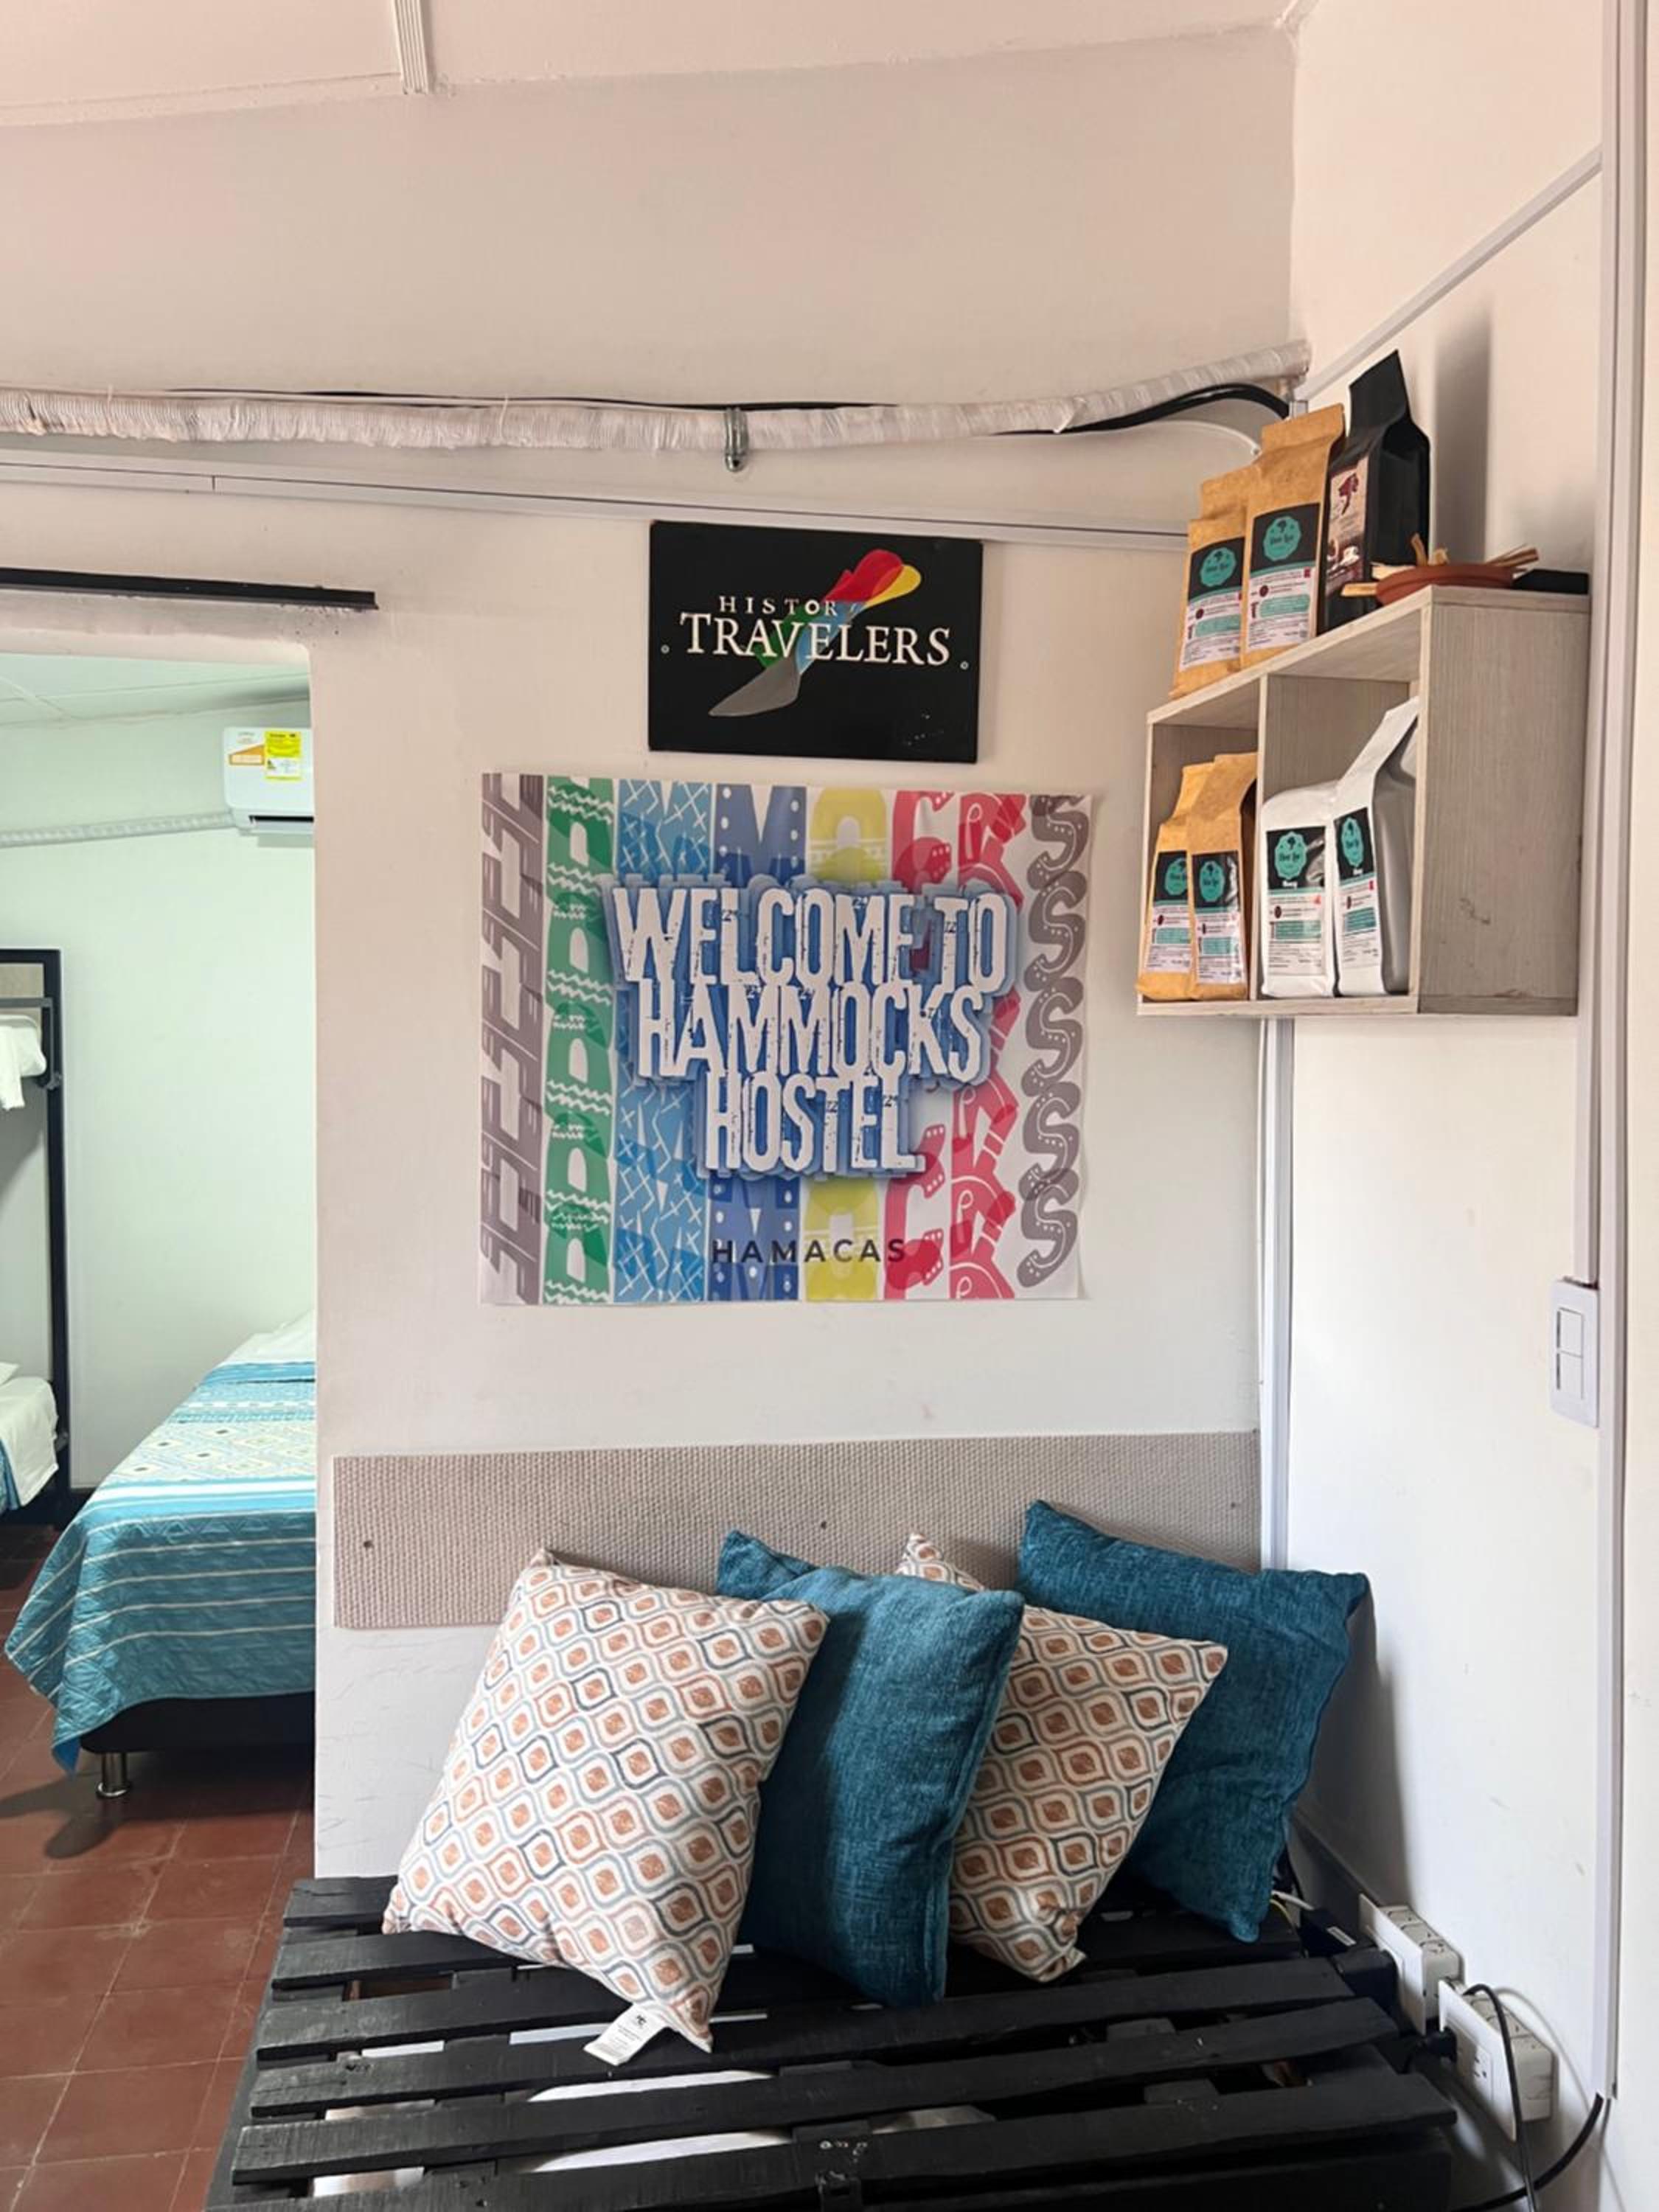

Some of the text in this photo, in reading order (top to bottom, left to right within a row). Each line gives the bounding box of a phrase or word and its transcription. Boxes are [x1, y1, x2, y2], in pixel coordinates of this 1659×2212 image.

[680, 612, 950, 667] TRAVELERS
[613, 888, 1007, 994] WELCOME TO
[639, 982, 984, 1082] HAMMOCKS
[705, 1071, 925, 1172] HOSTEL
[712, 1239, 905, 1263] HAMACAS
